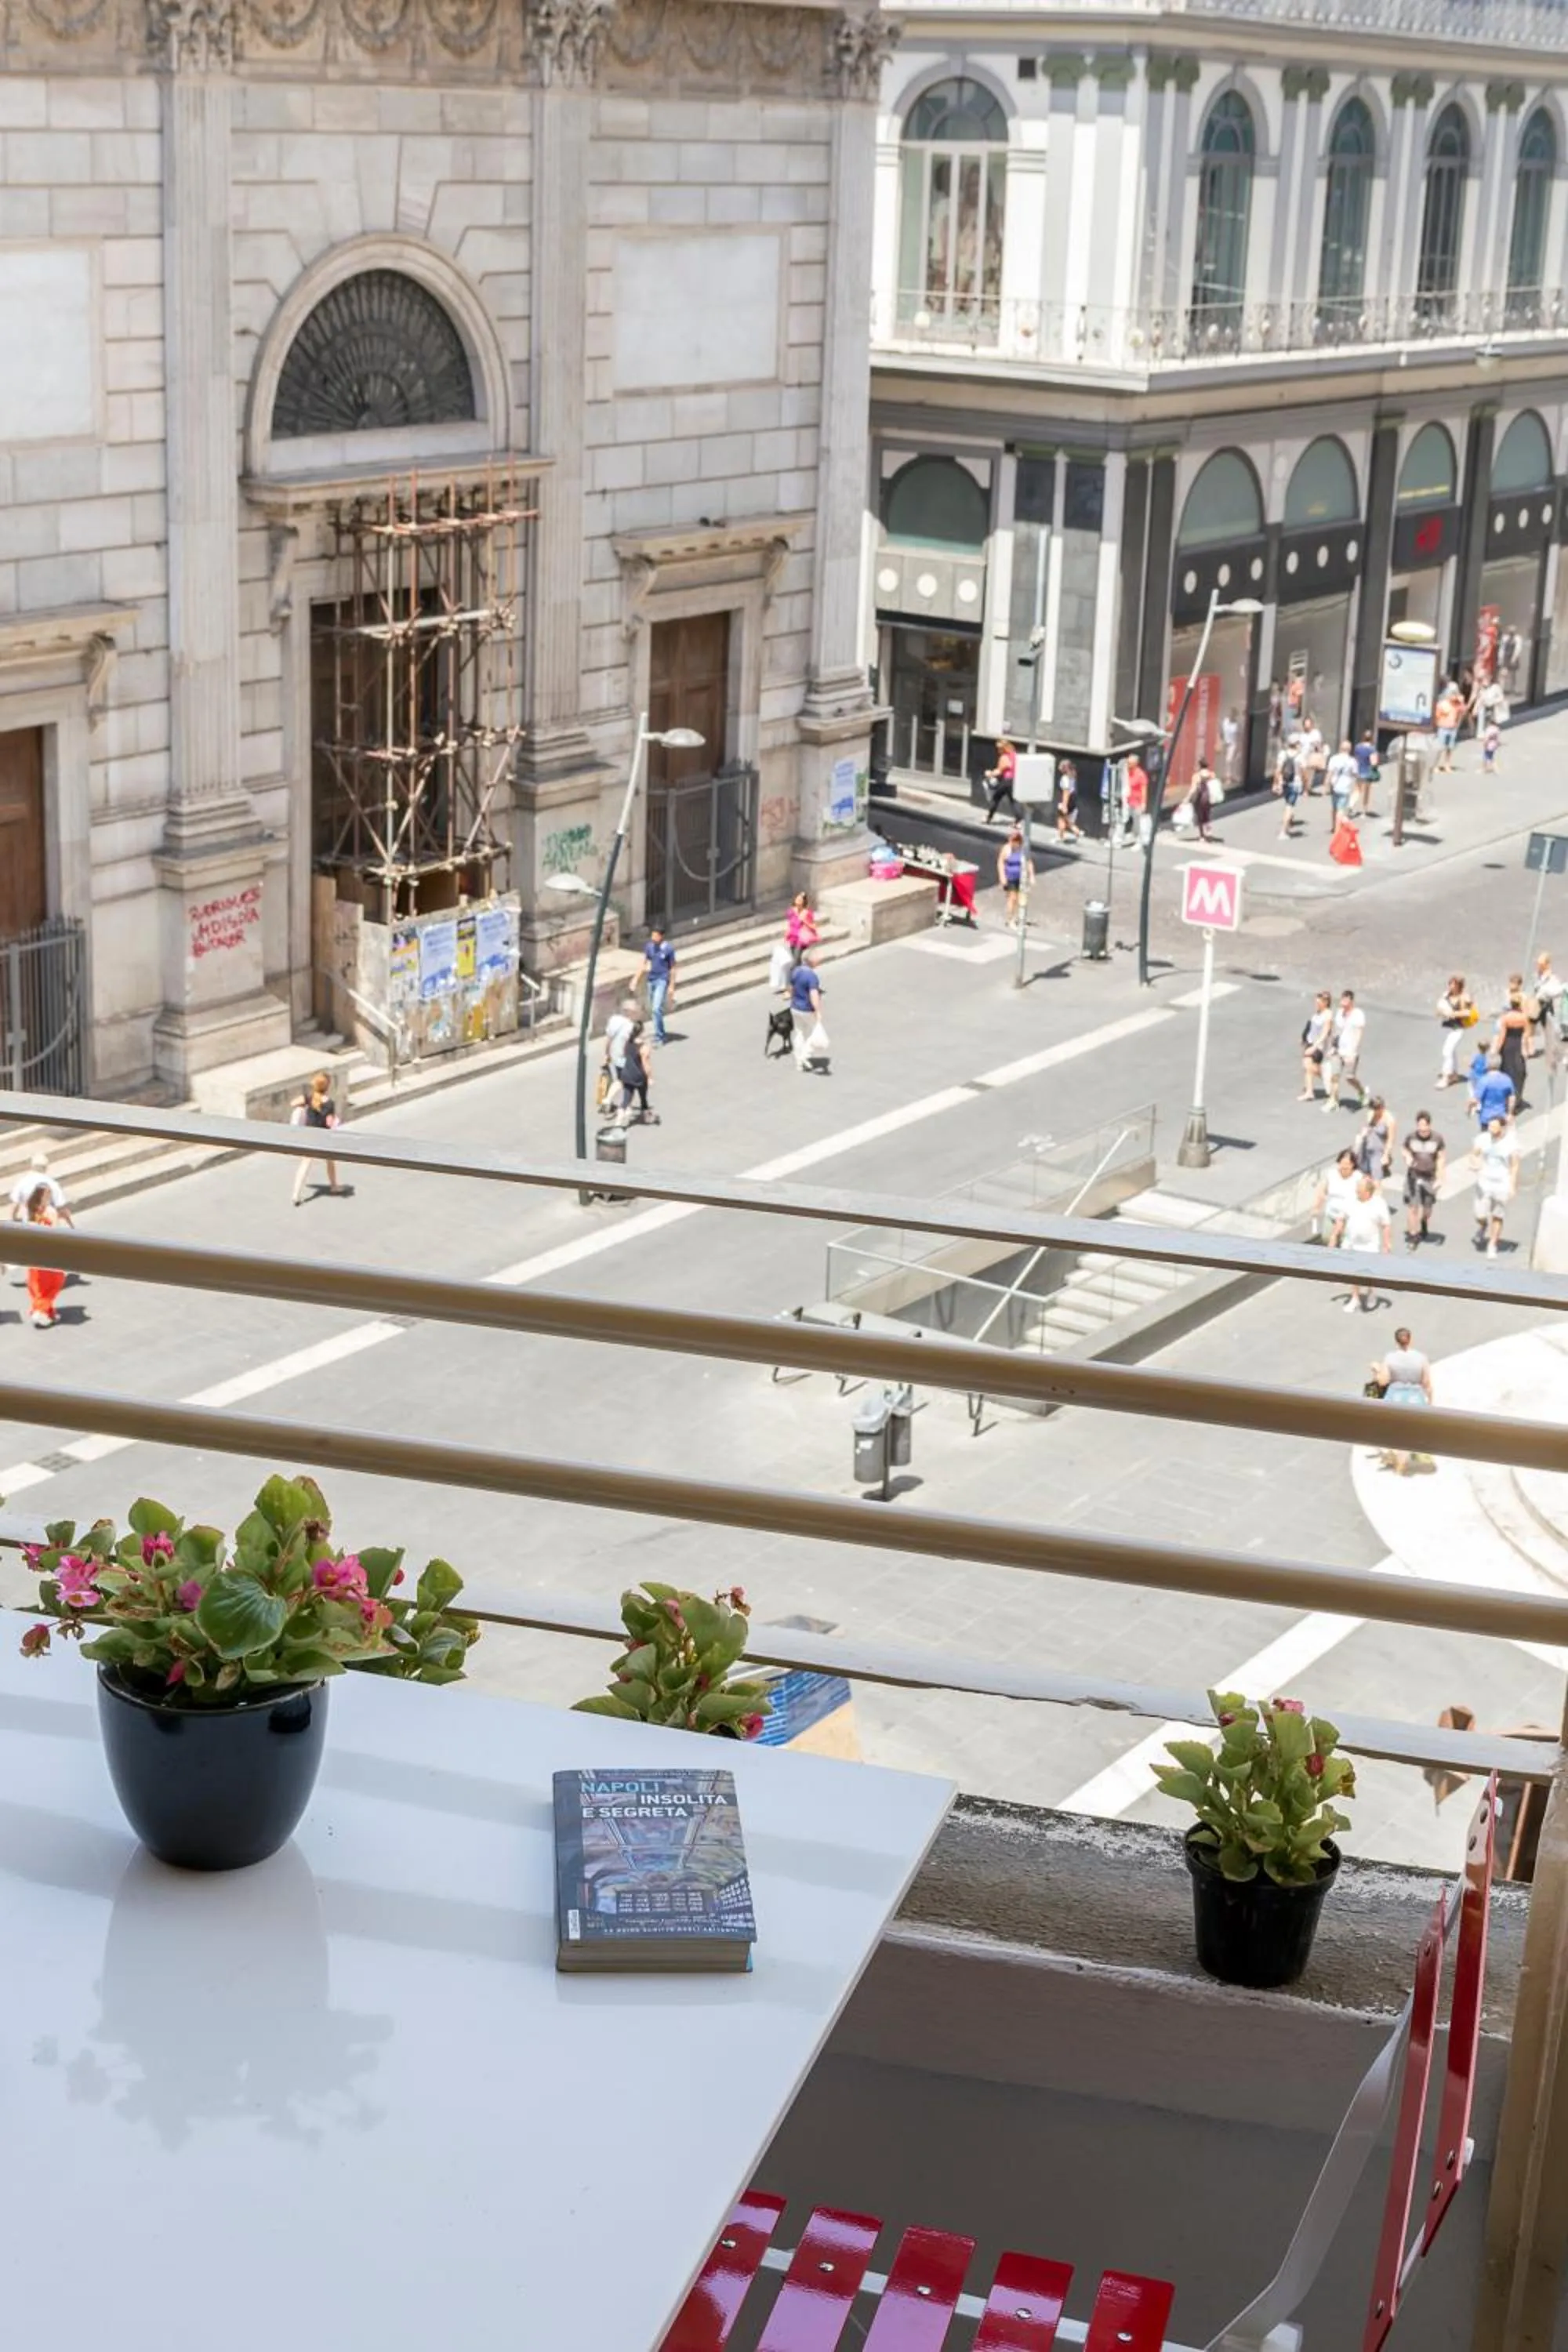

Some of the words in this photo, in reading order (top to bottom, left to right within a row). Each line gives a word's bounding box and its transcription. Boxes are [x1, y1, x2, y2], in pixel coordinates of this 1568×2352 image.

[1189, 877, 1231, 916] M
[581, 1782, 659, 1793] NAPOLI
[641, 1795, 728, 1805] INSOLITA
[583, 1807, 594, 1818] E
[598, 1807, 688, 1817] SEGRETA
